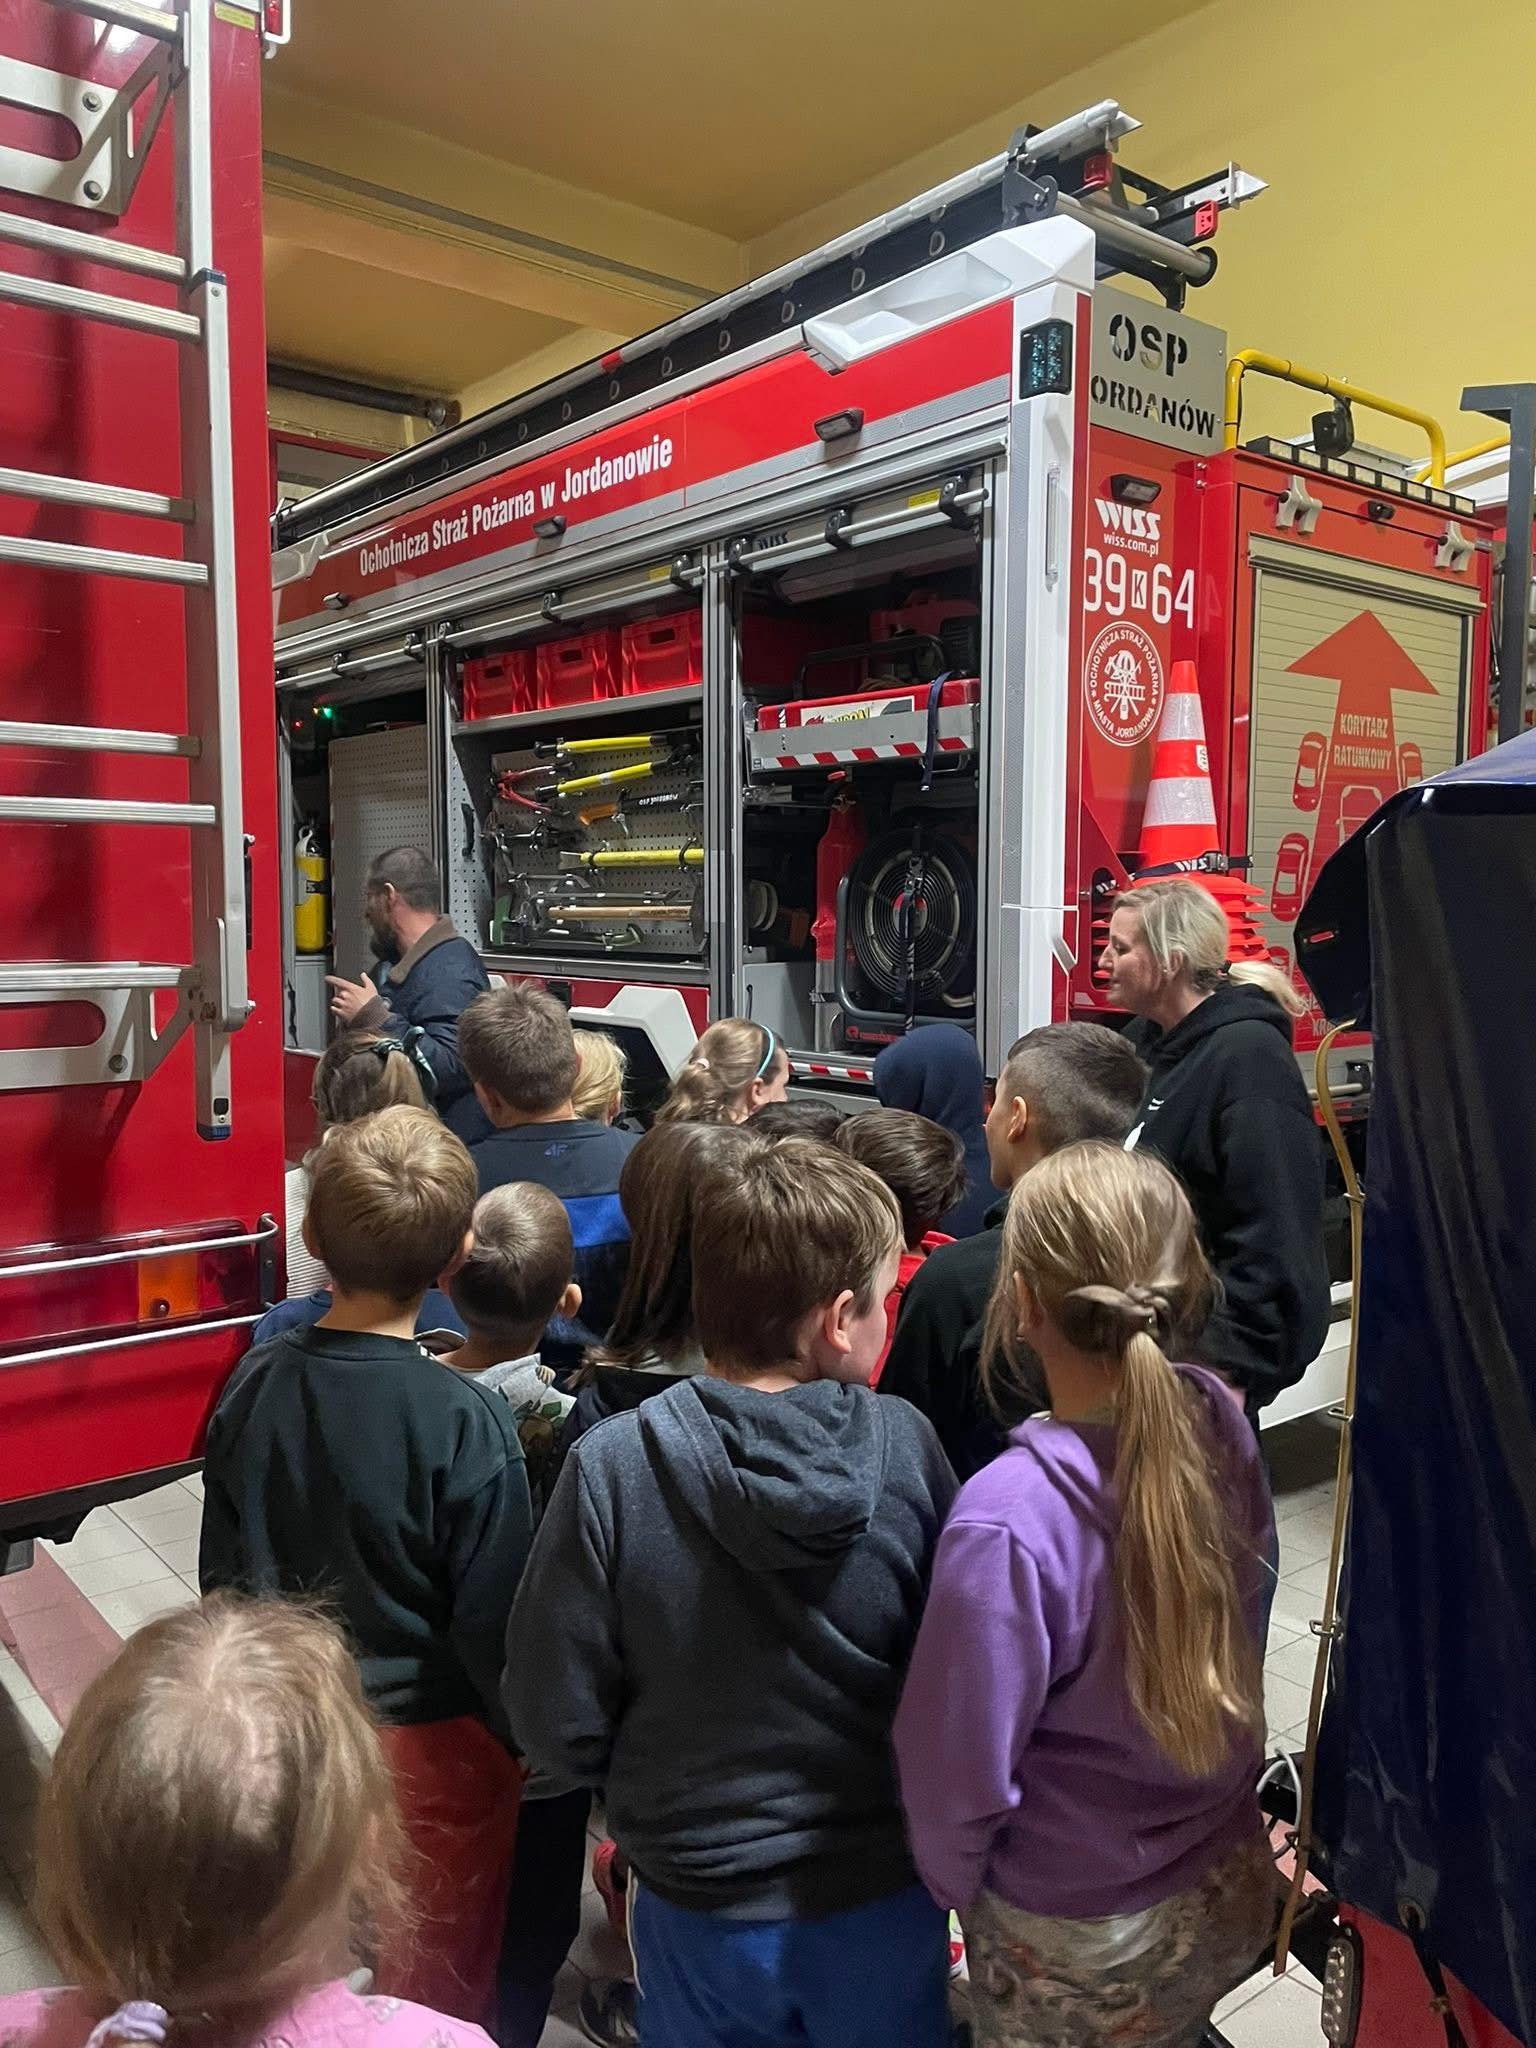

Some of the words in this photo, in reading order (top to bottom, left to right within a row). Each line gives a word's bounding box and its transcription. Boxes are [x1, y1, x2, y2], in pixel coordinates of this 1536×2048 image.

[1109, 314, 1188, 377] OSP
[1090, 375, 1216, 438] ORDANÓW
[360, 531, 429, 576] Ochotnicza
[432, 510, 468, 551] Straż
[472, 488, 535, 535] Pożarna
[540, 481, 556, 508] w
[561, 434, 673, 503] Jordanowie
[1094, 498, 1161, 541] WISS
[1103, 531, 1159, 558] wiss.com.pl
[1090, 630, 1120, 688] OCHOTNICZA
[1093, 699, 1115, 734] MIASTA
[1340, 713, 1389, 739] KORYTARZ
[1333, 745, 1393, 771] RATUNKOWY
